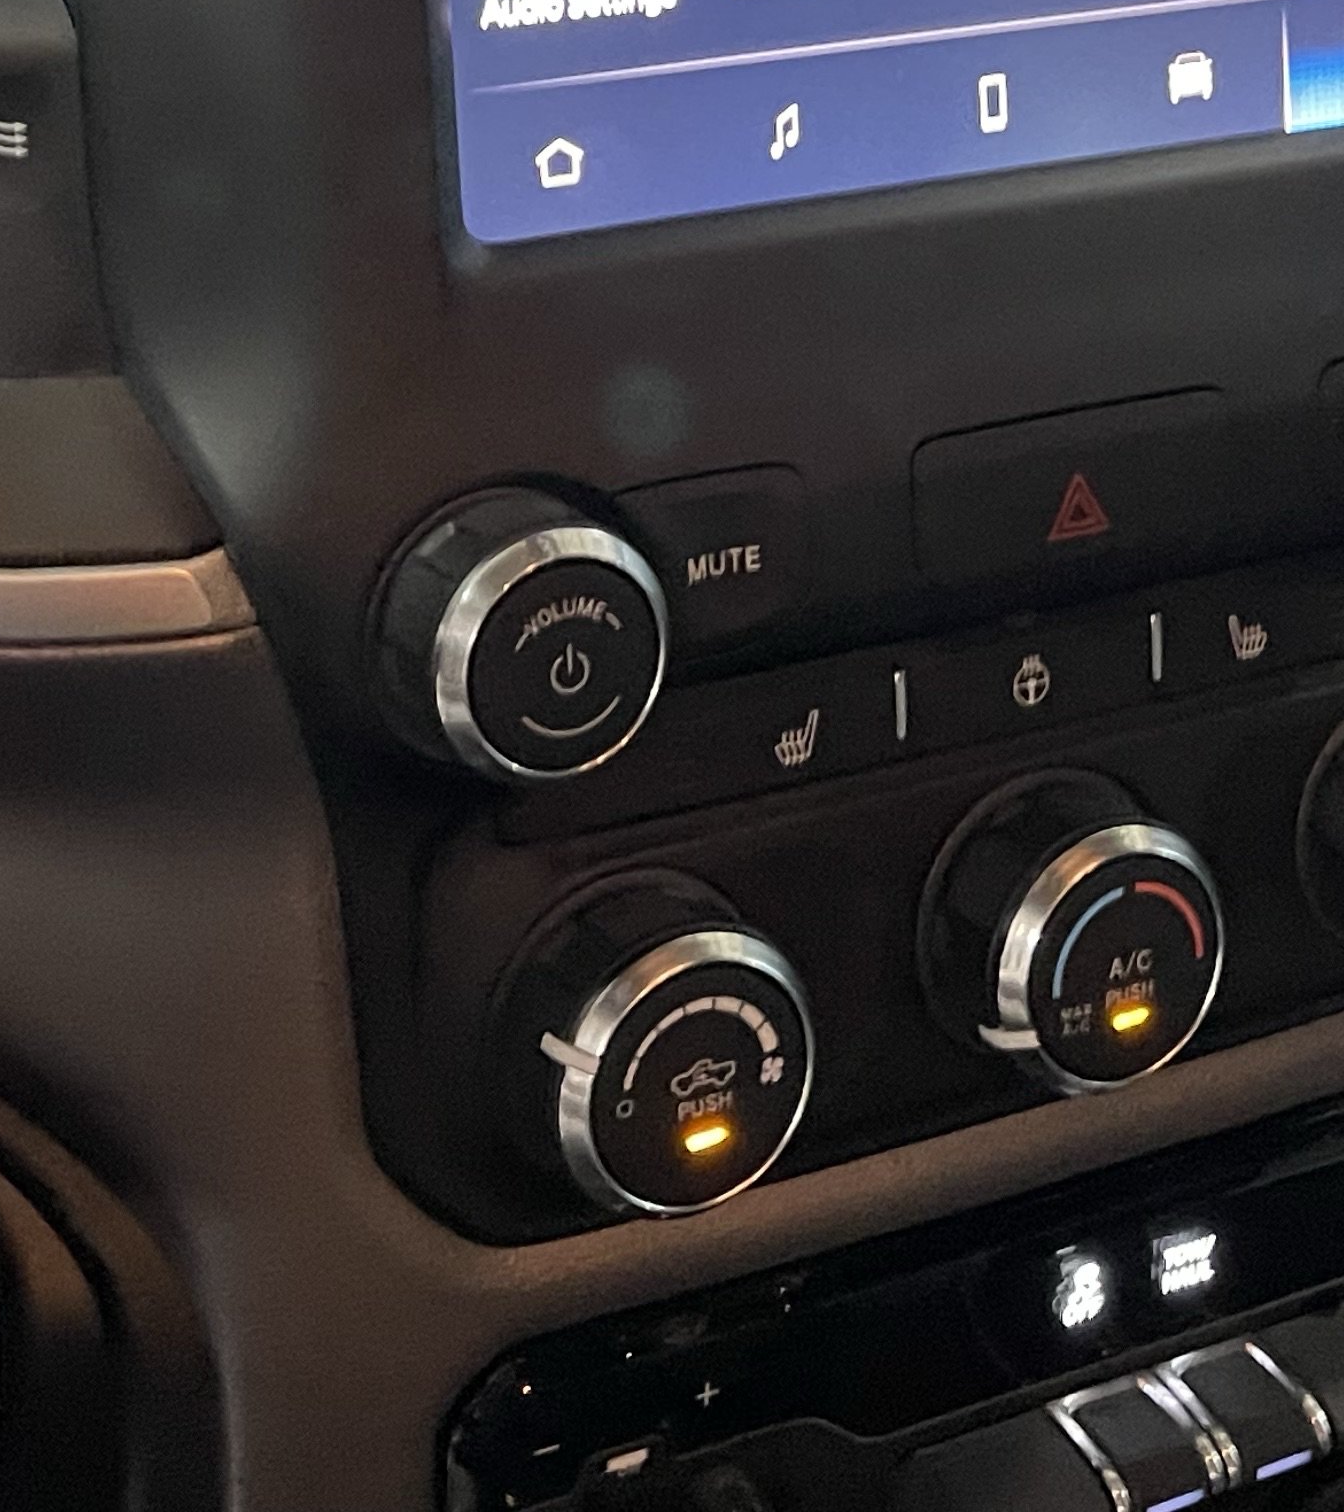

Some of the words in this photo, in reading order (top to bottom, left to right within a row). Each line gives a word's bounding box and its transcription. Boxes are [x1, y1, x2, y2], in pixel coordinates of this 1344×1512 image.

[687, 544, 762, 587] MUTE
[522, 595, 608, 638] VOLUME
[1108, 947, 1154, 981] A/C
[677, 1090, 734, 1122] PUSH
